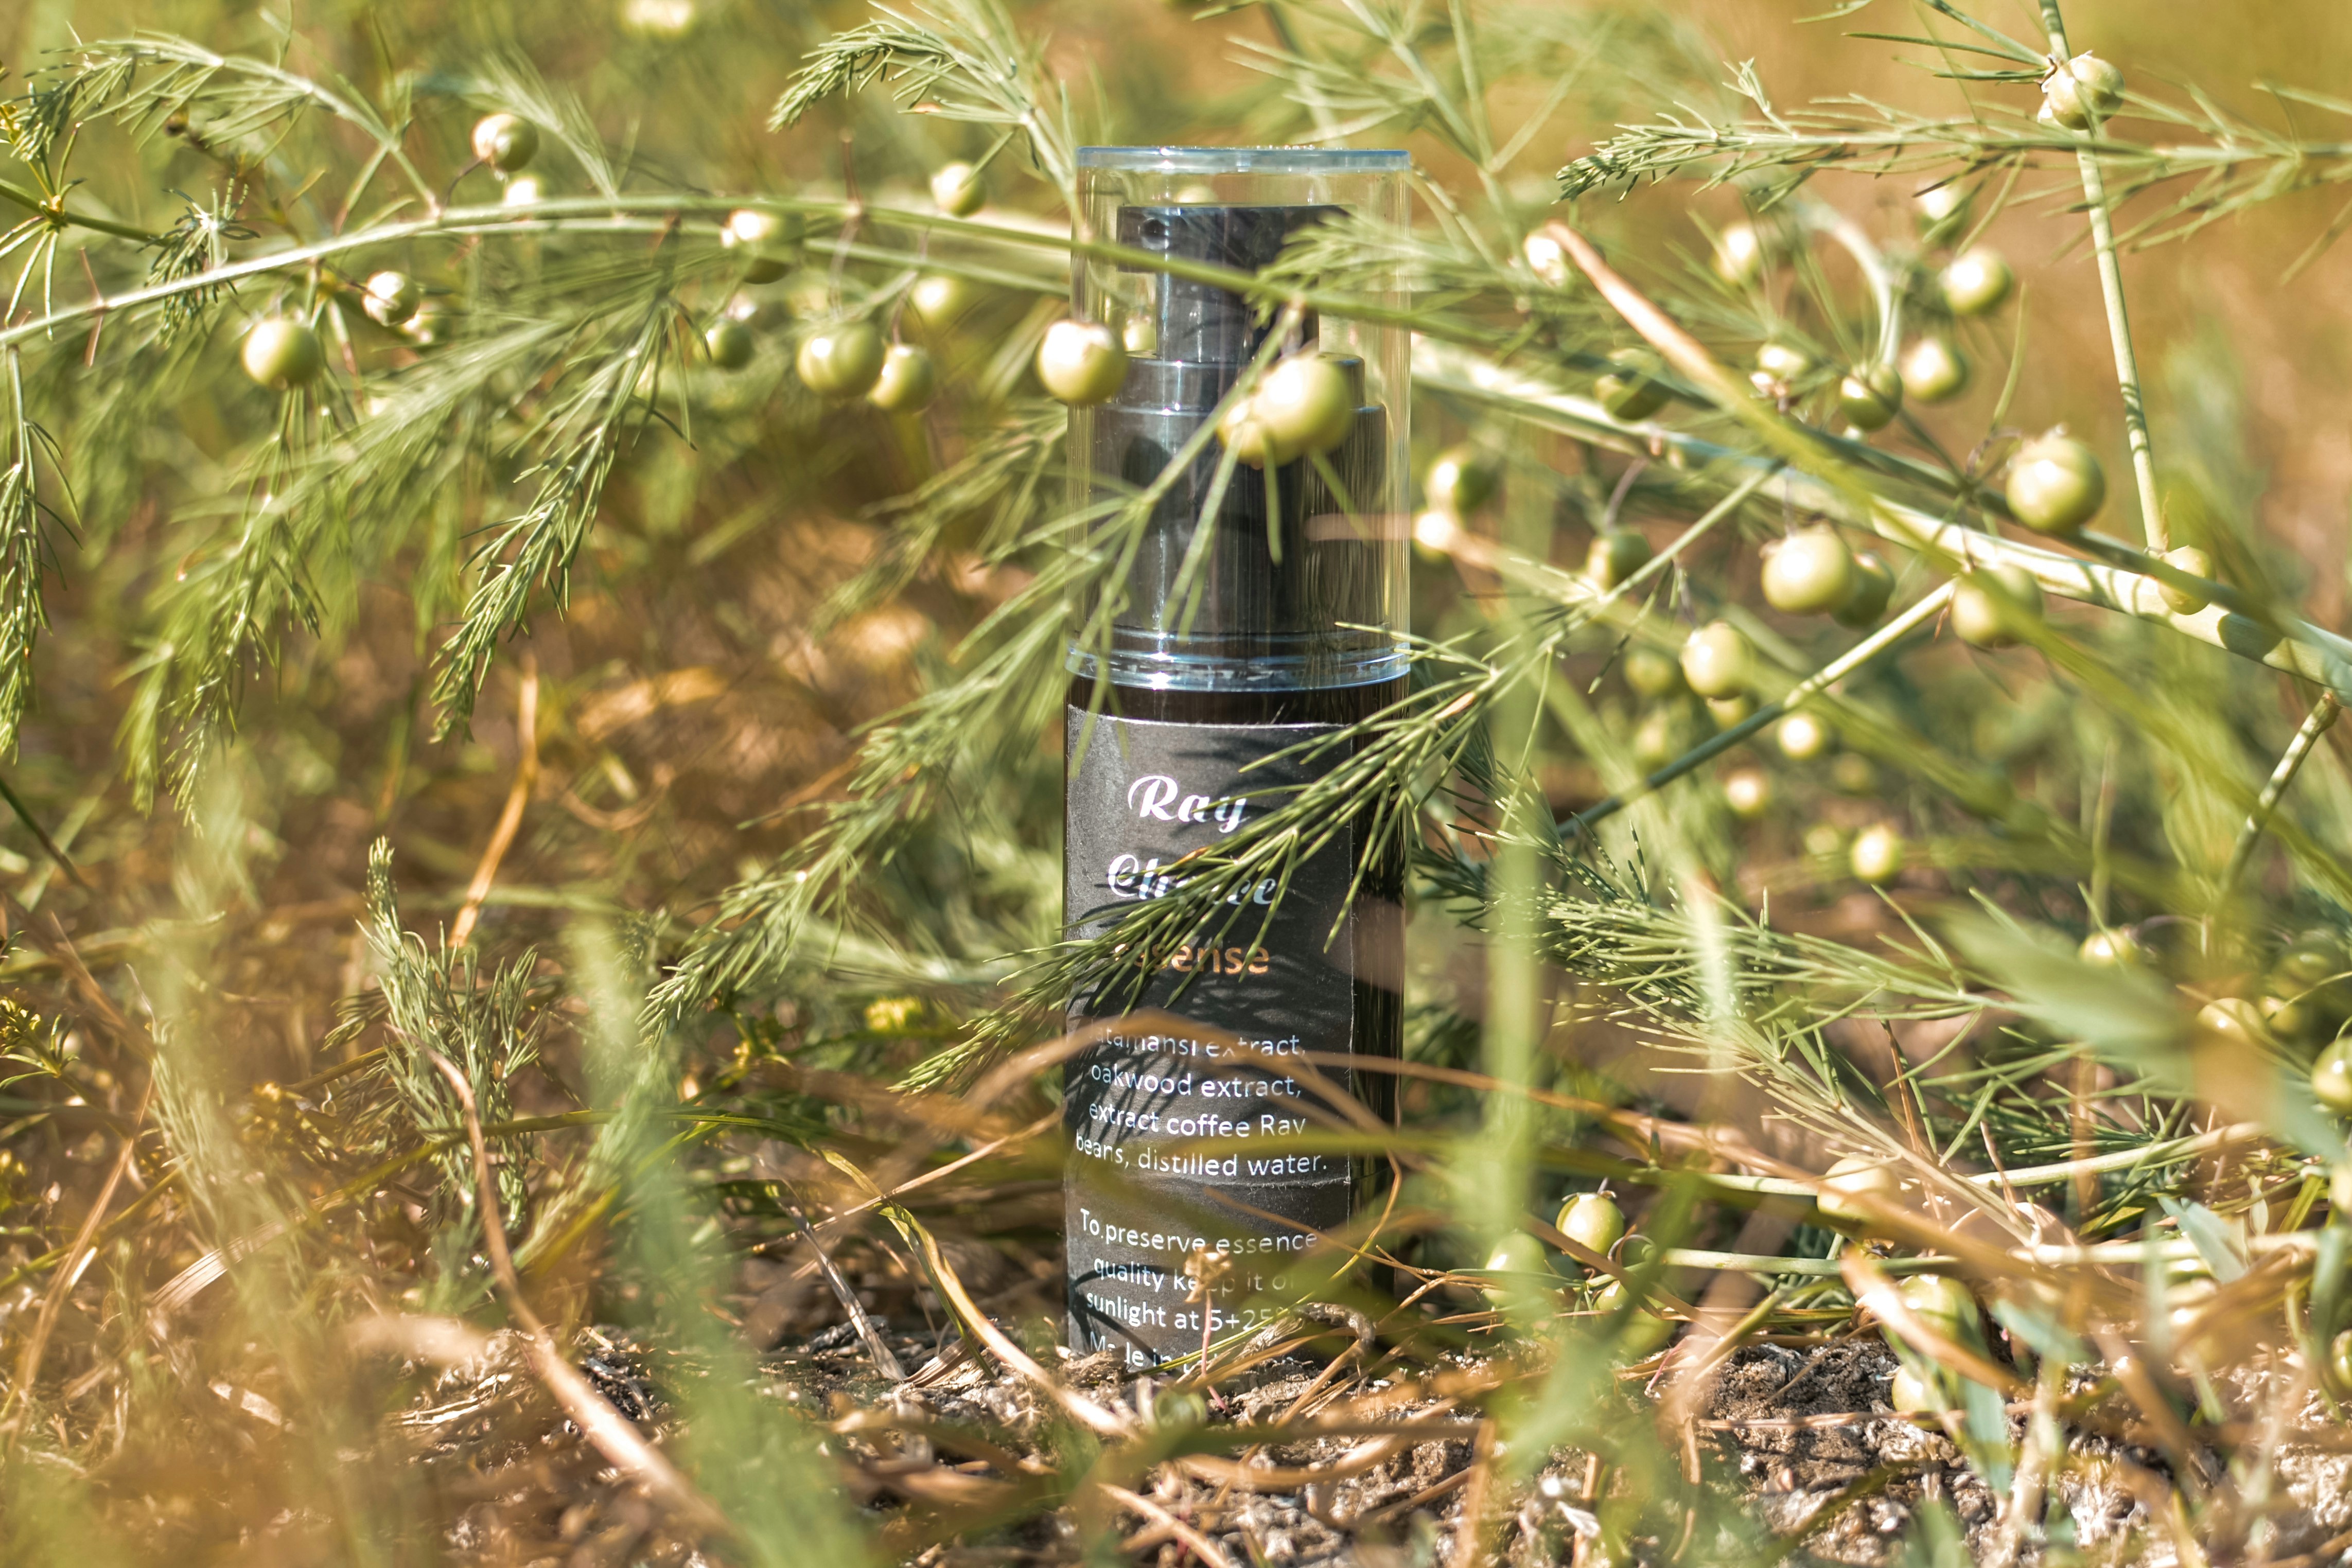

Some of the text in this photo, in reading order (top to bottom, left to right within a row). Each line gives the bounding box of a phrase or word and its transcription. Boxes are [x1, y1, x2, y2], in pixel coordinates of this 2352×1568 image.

[1128, 775, 1251, 833] Ray
[1092, 1064, 1302, 1098] oakwood extract,
[1089, 1103, 1159, 1132] extract
[1167, 1114, 1250, 1137] coffee
[1076, 1130, 1327, 1176] beans, distilled water.
[1106, 1224, 1206, 1253] preserve
[1216, 1232, 1318, 1254] essence
[1094, 1258, 1165, 1292] quality
[1173, 1269, 1235, 1297] kep
[1247, 1271, 1262, 1291] it
[1086, 1292, 1167, 1328] sunlight
[1174, 1311, 1199, 1331] at
